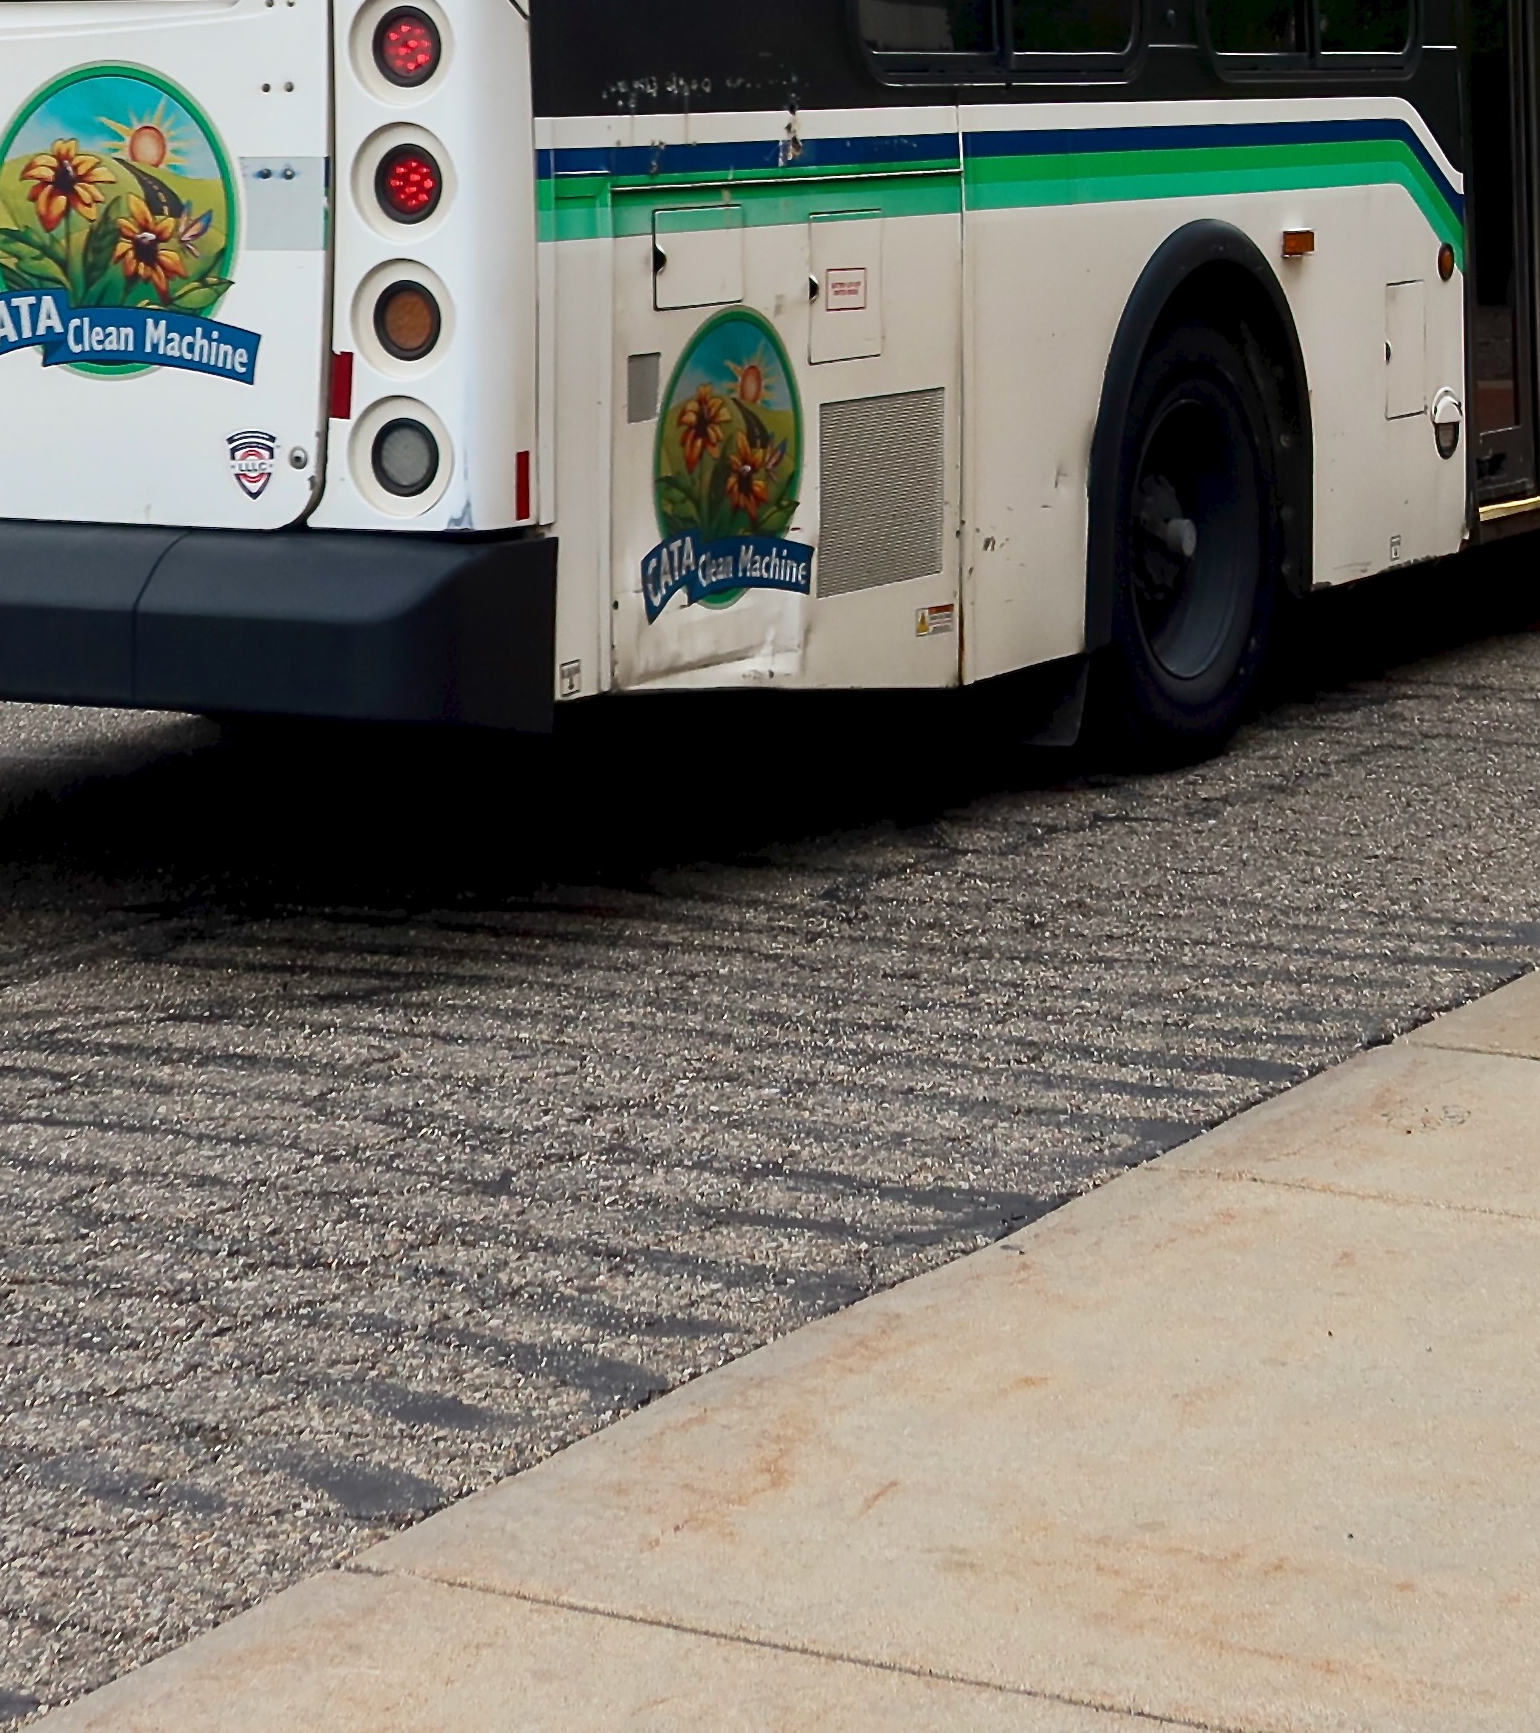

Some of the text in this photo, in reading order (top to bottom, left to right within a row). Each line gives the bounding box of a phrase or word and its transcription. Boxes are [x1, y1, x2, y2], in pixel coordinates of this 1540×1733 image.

[66, 317, 135, 354] Clean
[143, 317, 250, 374] Machine
[646, 536, 808, 607] CATA Clean Machine
